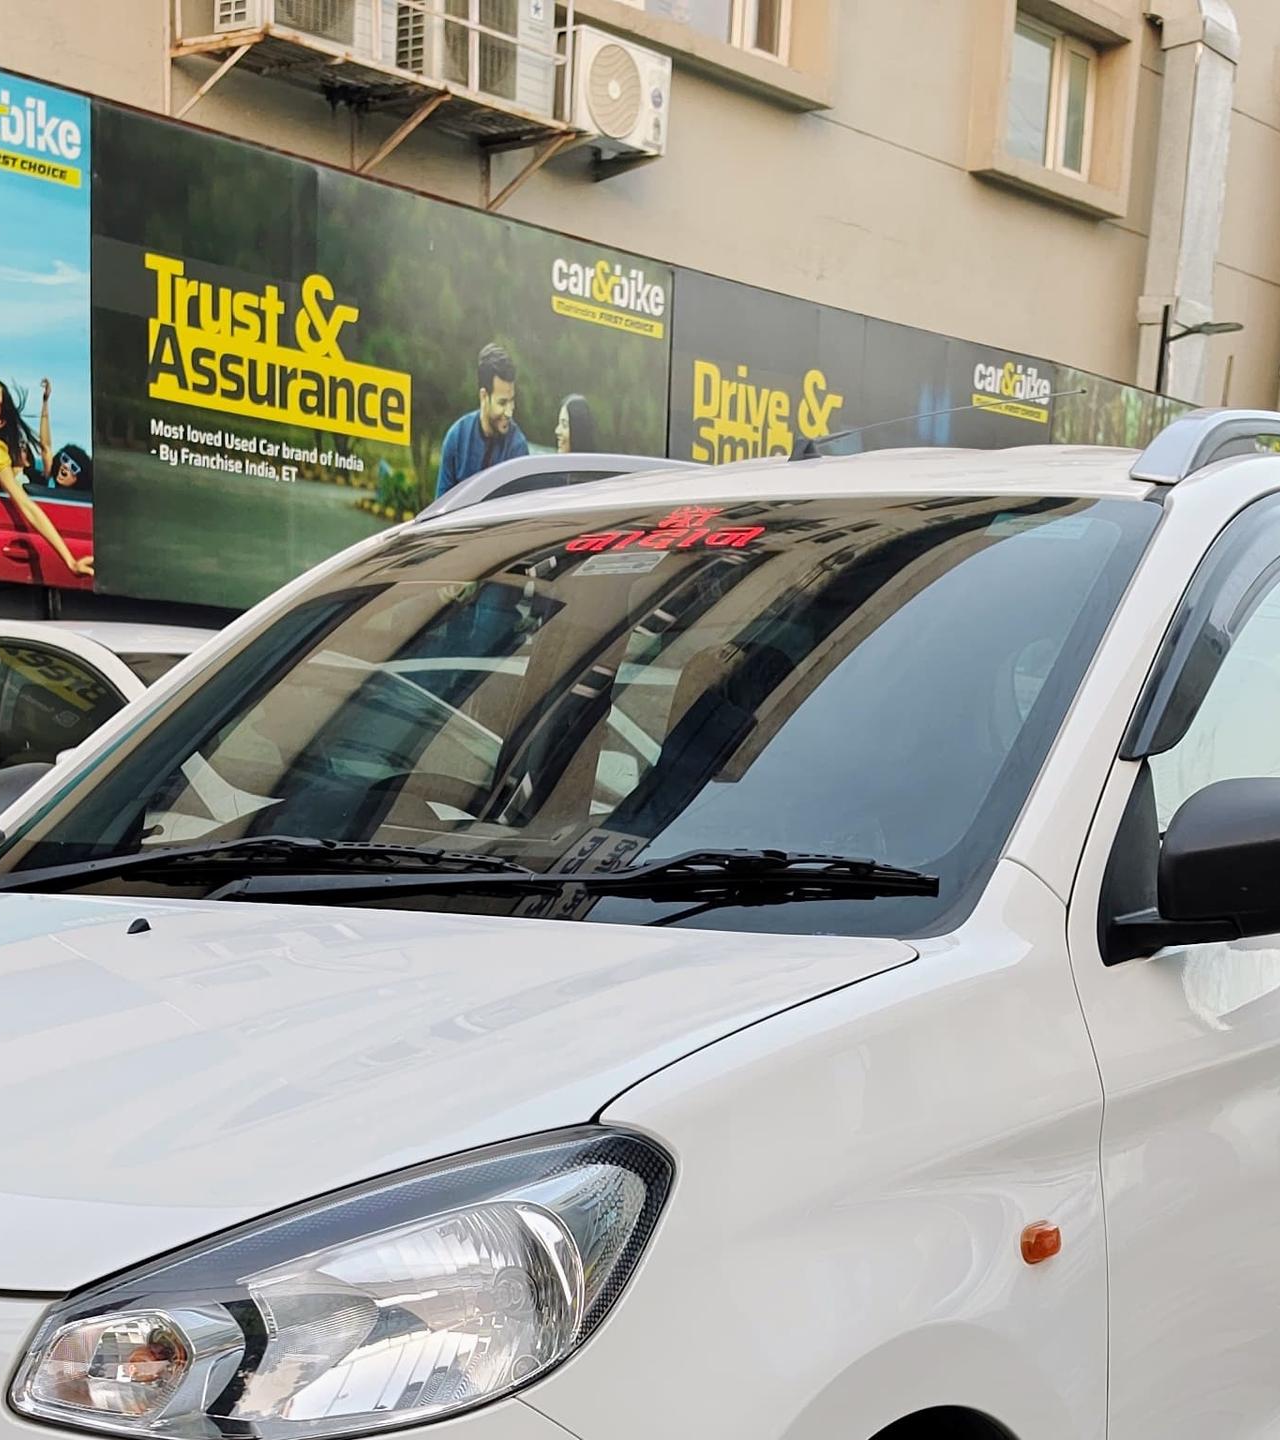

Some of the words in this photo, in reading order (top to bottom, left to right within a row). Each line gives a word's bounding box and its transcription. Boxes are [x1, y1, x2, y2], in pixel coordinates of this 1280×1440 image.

[20, 160, 67, 180] CHOICE
[145, 252, 284, 347] Trust
[296, 274, 359, 360] &
[552, 258, 665, 316] car&bike
[149, 323, 405, 432] Assurance
[693, 360, 790, 430] Drive
[798, 370, 843, 439] &
[151, 419, 184, 440] Most
[187, 425, 222, 447] loved
[225, 433, 257, 453] Used
[259, 439, 280, 456] Car
[282, 442, 317, 463] brand
[320, 450, 333, 466] of
[335, 454, 364, 473] India
[160, 444, 178, 466] By
[181, 449, 242, 473] Franchise
[245, 459, 280, 481] India,
[282, 465, 298, 482] ET
